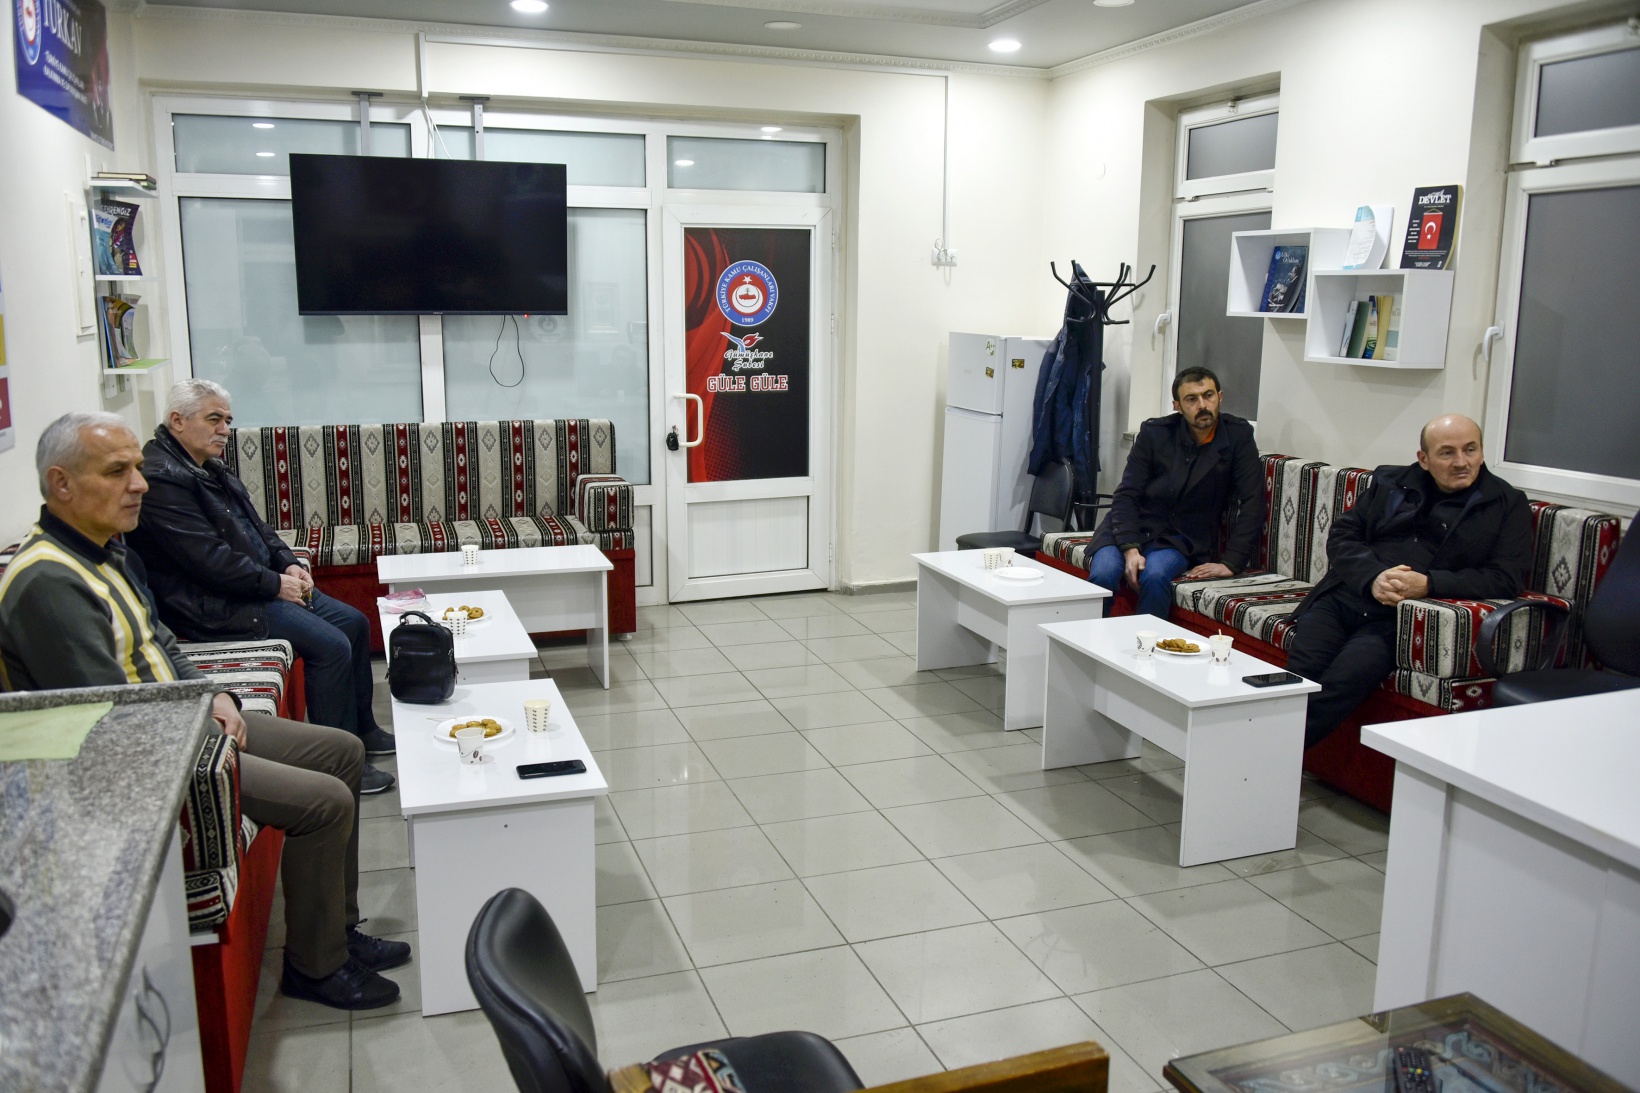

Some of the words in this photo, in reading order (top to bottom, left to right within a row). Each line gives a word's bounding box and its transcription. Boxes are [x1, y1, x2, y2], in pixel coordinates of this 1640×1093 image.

[1418, 194, 1452, 205] DEVLET
[724, 266, 741, 283] KAMU
[742, 264, 775, 293] ÇALIŞANLARI
[720, 282, 731, 313] TÜRKİYE
[765, 293, 776, 313] VAKFI
[724, 349, 774, 361] Gümüşhane
[731, 359, 765, 372] Şubesi
[707, 374, 746, 392] GÜLE
[750, 373, 788, 391] GÜLE
